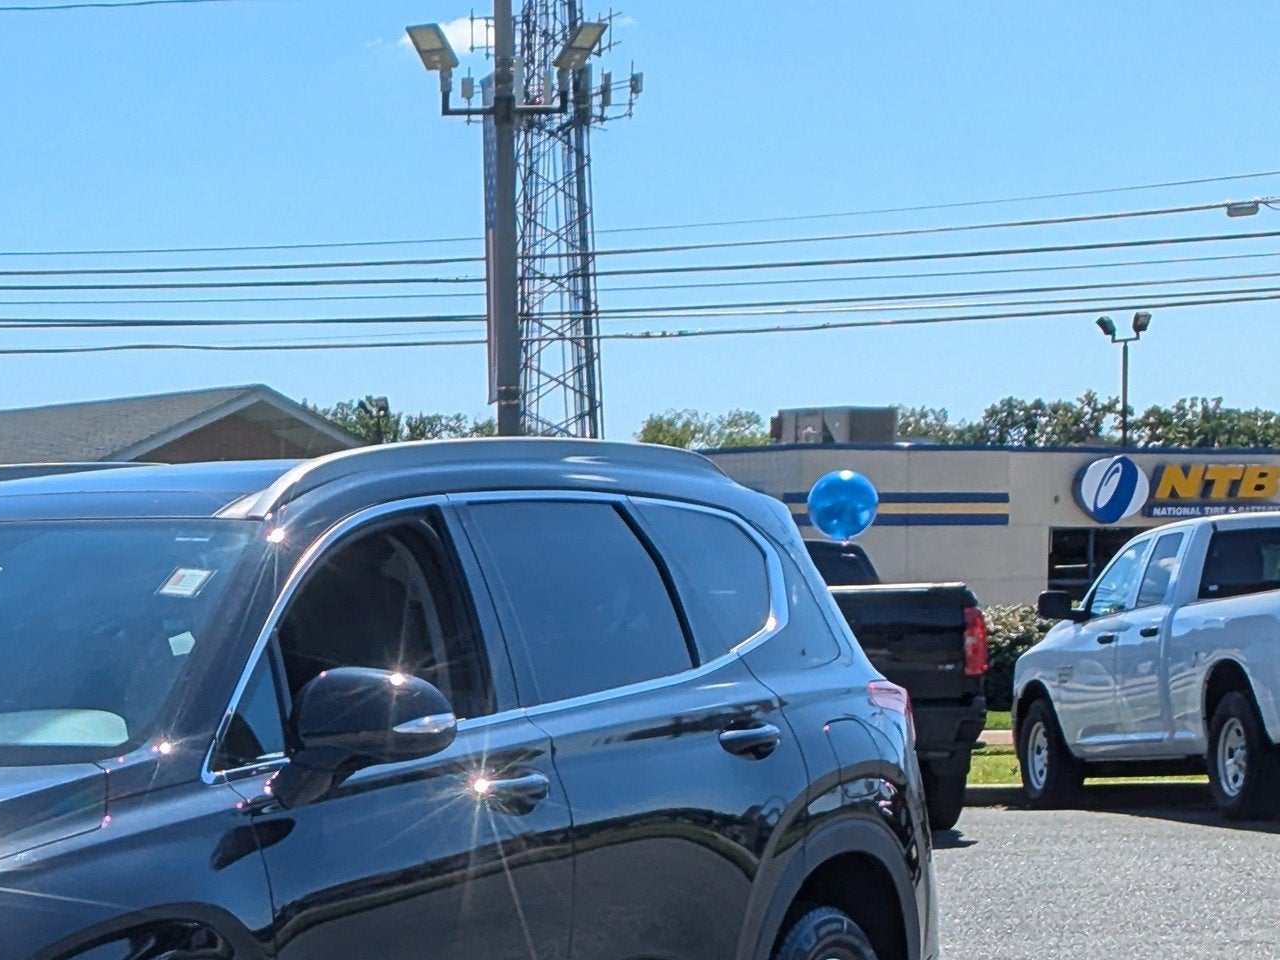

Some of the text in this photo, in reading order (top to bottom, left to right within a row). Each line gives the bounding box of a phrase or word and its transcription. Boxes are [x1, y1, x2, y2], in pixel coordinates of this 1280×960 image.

[1155, 463, 1280, 499] NTB
[1153, 506, 1201, 516] NATIONAL
[1204, 506, 1226, 515] TIRE
